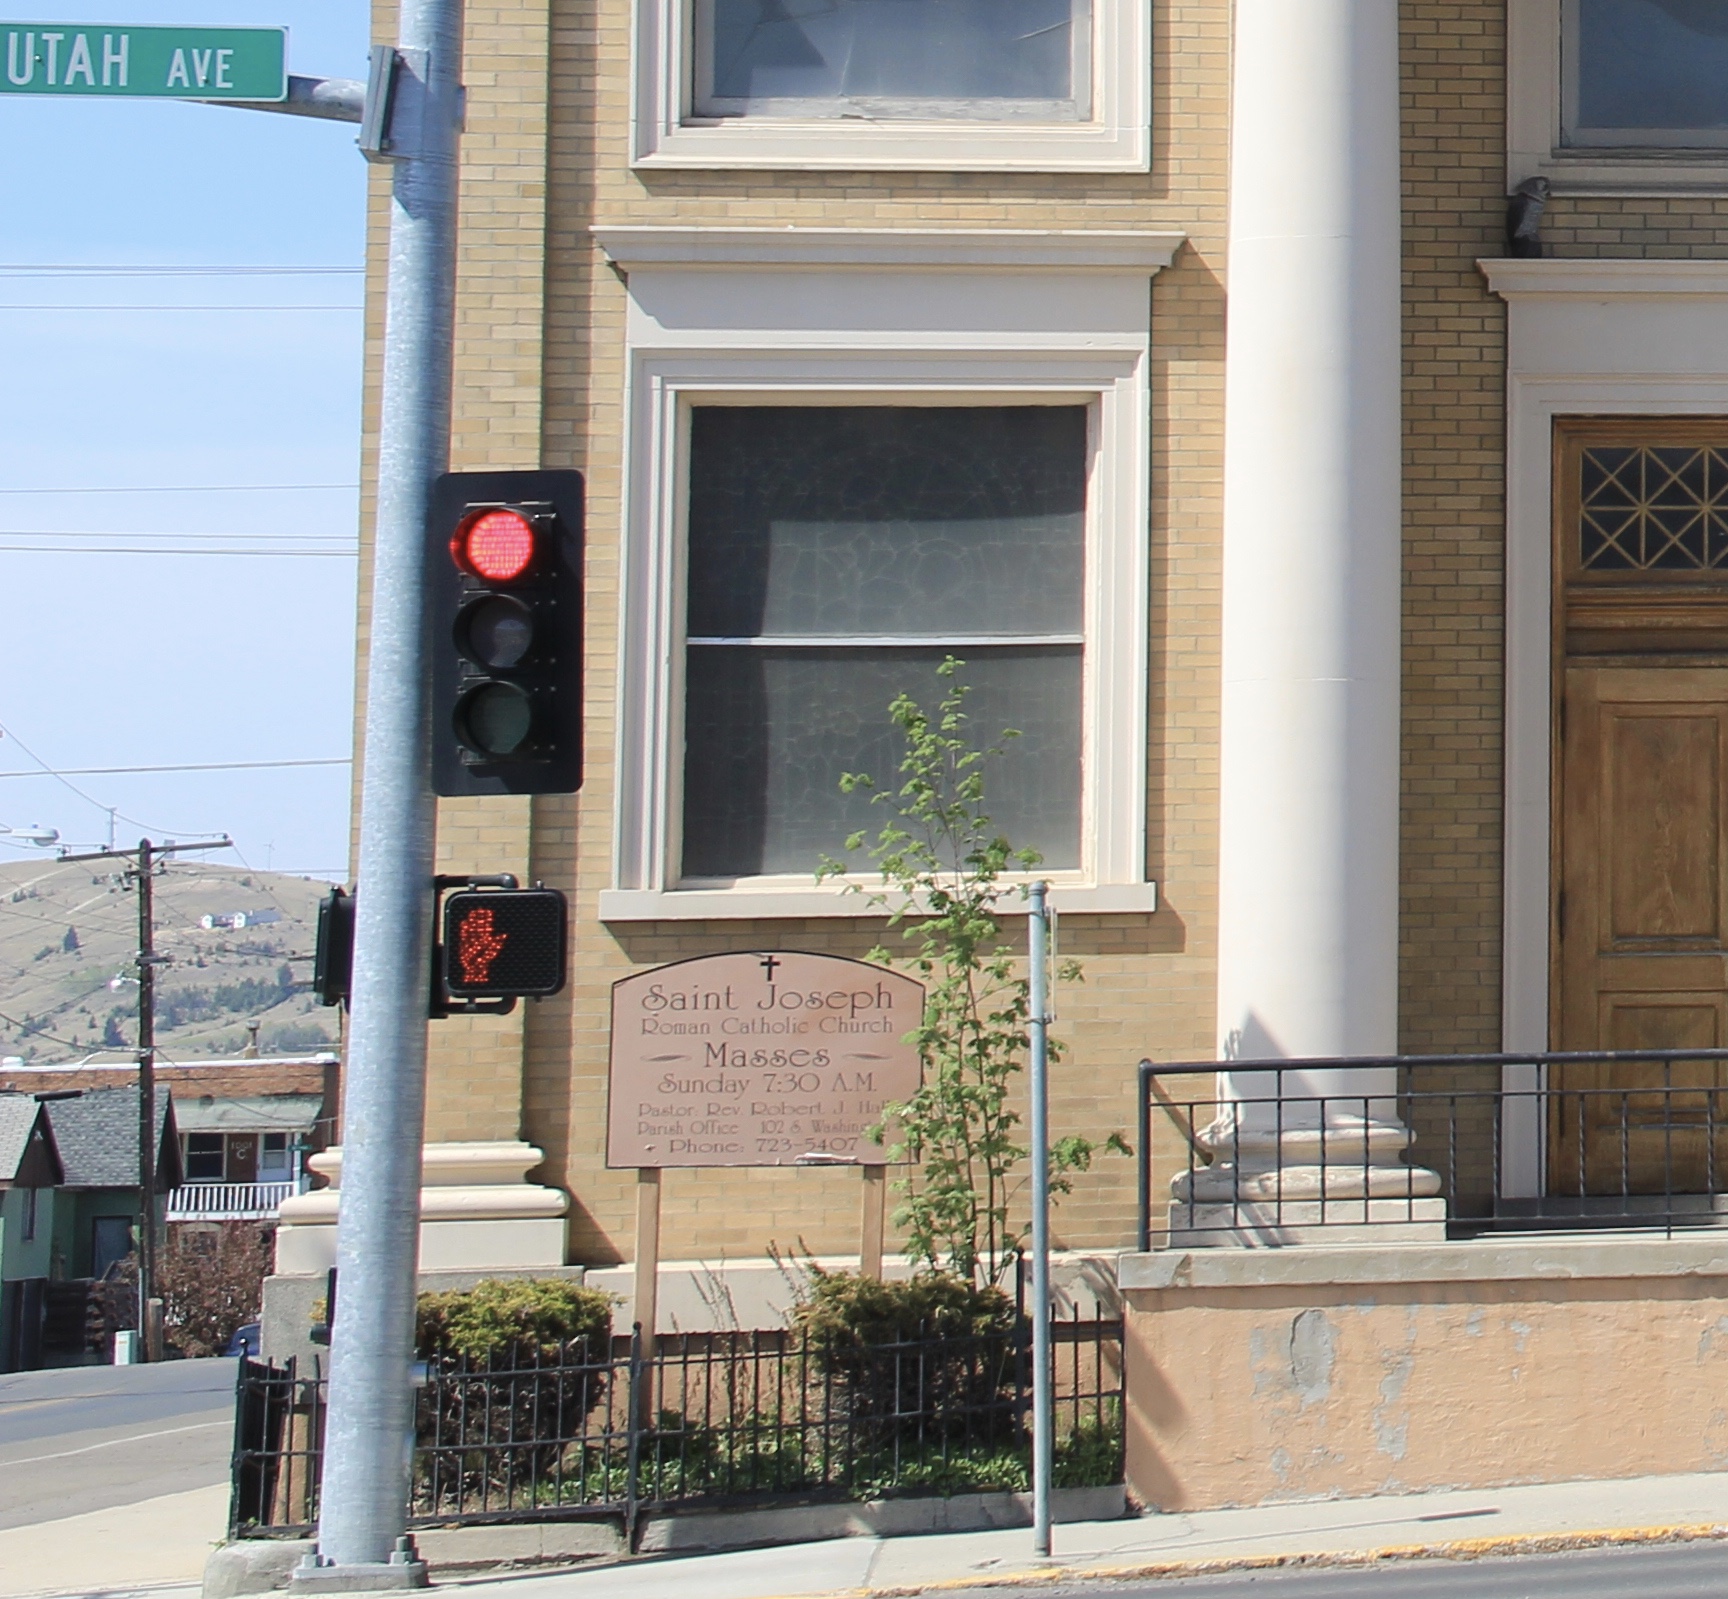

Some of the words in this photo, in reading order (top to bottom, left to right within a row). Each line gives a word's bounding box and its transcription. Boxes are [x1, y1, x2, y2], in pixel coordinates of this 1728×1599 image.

[8, 31, 130, 87] UTAH
[166, 48, 235, 89] AVE
[641, 984, 740, 1011] Saint
[757, 981, 893, 1019] Joseph
[641, 1017, 711, 1036] Roman
[721, 1016, 809, 1035] Catholic
[819, 1015, 893, 1034] Church
[703, 1041, 831, 1068] Masses
[657, 1072, 751, 1100] Sunday
[763, 1072, 820, 1093] 7:30
[832, 1072, 877, 1092] A.M.
[750, 1101, 825, 1116] Robert
[637, 1120, 684, 1136] Parish
[689, 1119, 740, 1135] Office
[760, 1119, 785, 1134] 102
[669, 1139, 745, 1154] Phone:
[755, 1137, 860, 1153] 723-5407
